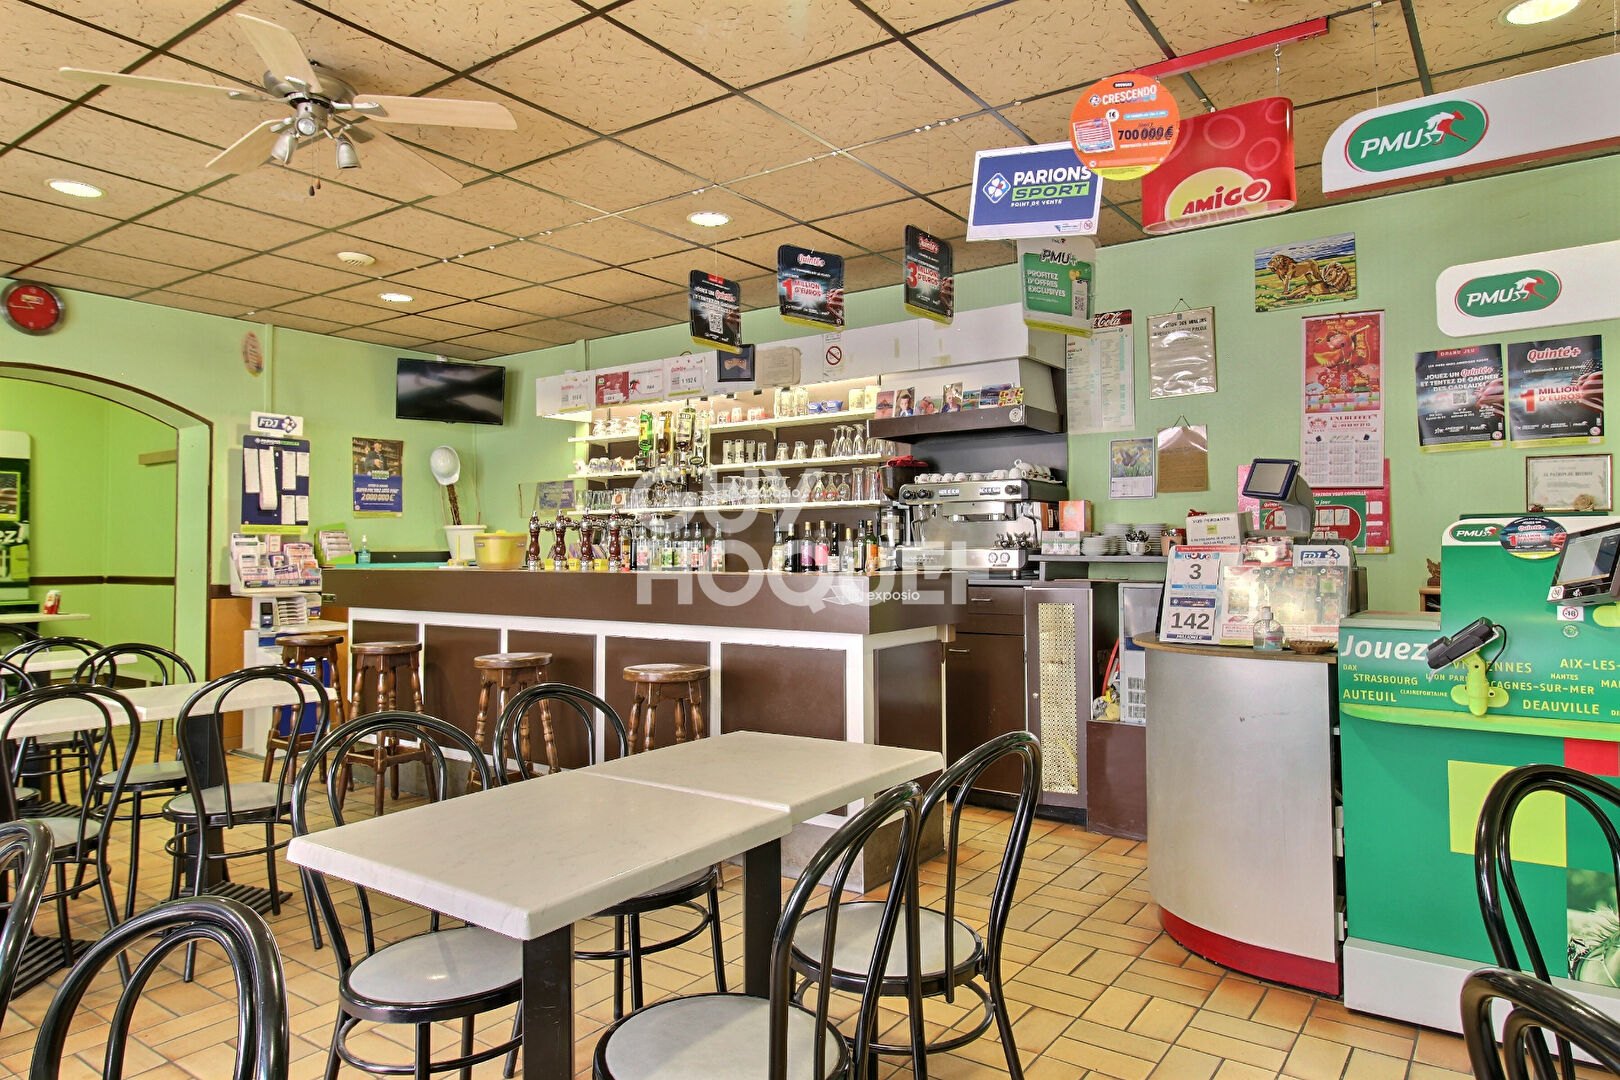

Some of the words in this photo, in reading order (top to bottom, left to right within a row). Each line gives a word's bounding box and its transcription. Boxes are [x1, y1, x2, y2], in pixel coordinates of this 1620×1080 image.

[1102, 84, 1157, 105] CRESCENDO
[1117, 129, 1139, 141] 700
[1360, 127, 1426, 160] PMU
[1013, 166, 1092, 187] PARIONS
[1014, 183, 1087, 200] SPORT
[906, 262, 918, 288] 3
[1027, 270, 1058, 280] PROFITEZ
[781, 278, 793, 301] 1
[1027, 278, 1058, 288] D'OFFRES
[1028, 286, 1066, 297] EXCLUSIVES
[1466, 288, 1514, 308] PMU
[1527, 345, 1582, 363] Quinté+
[1425, 372, 1449, 381] JOUEZ
[1429, 378, 1455, 386] TENTEZ
[1468, 373, 1500, 382] GAGNER
[1520, 389, 1536, 413] 1
[1538, 385, 1580, 395] MILLION
[1538, 393, 1582, 402] D'EUROS
[258, 417, 279, 429] FDJ
[1456, 529, 1484, 537] PMU
[1508, 535, 1518, 547] 1
[1189, 563, 1202, 580] 3
[1170, 612, 1210, 630] 142
[1342, 663, 1358, 671] DAX
[1353, 673, 1419, 685] STRASBOURG
[1550, 673, 1579, 681] NANTES
[1601, 680, 1620, 689] MA
[1343, 688, 1397, 703] AUTEUIL
[1522, 699, 1600, 715] DEAUVILLE
